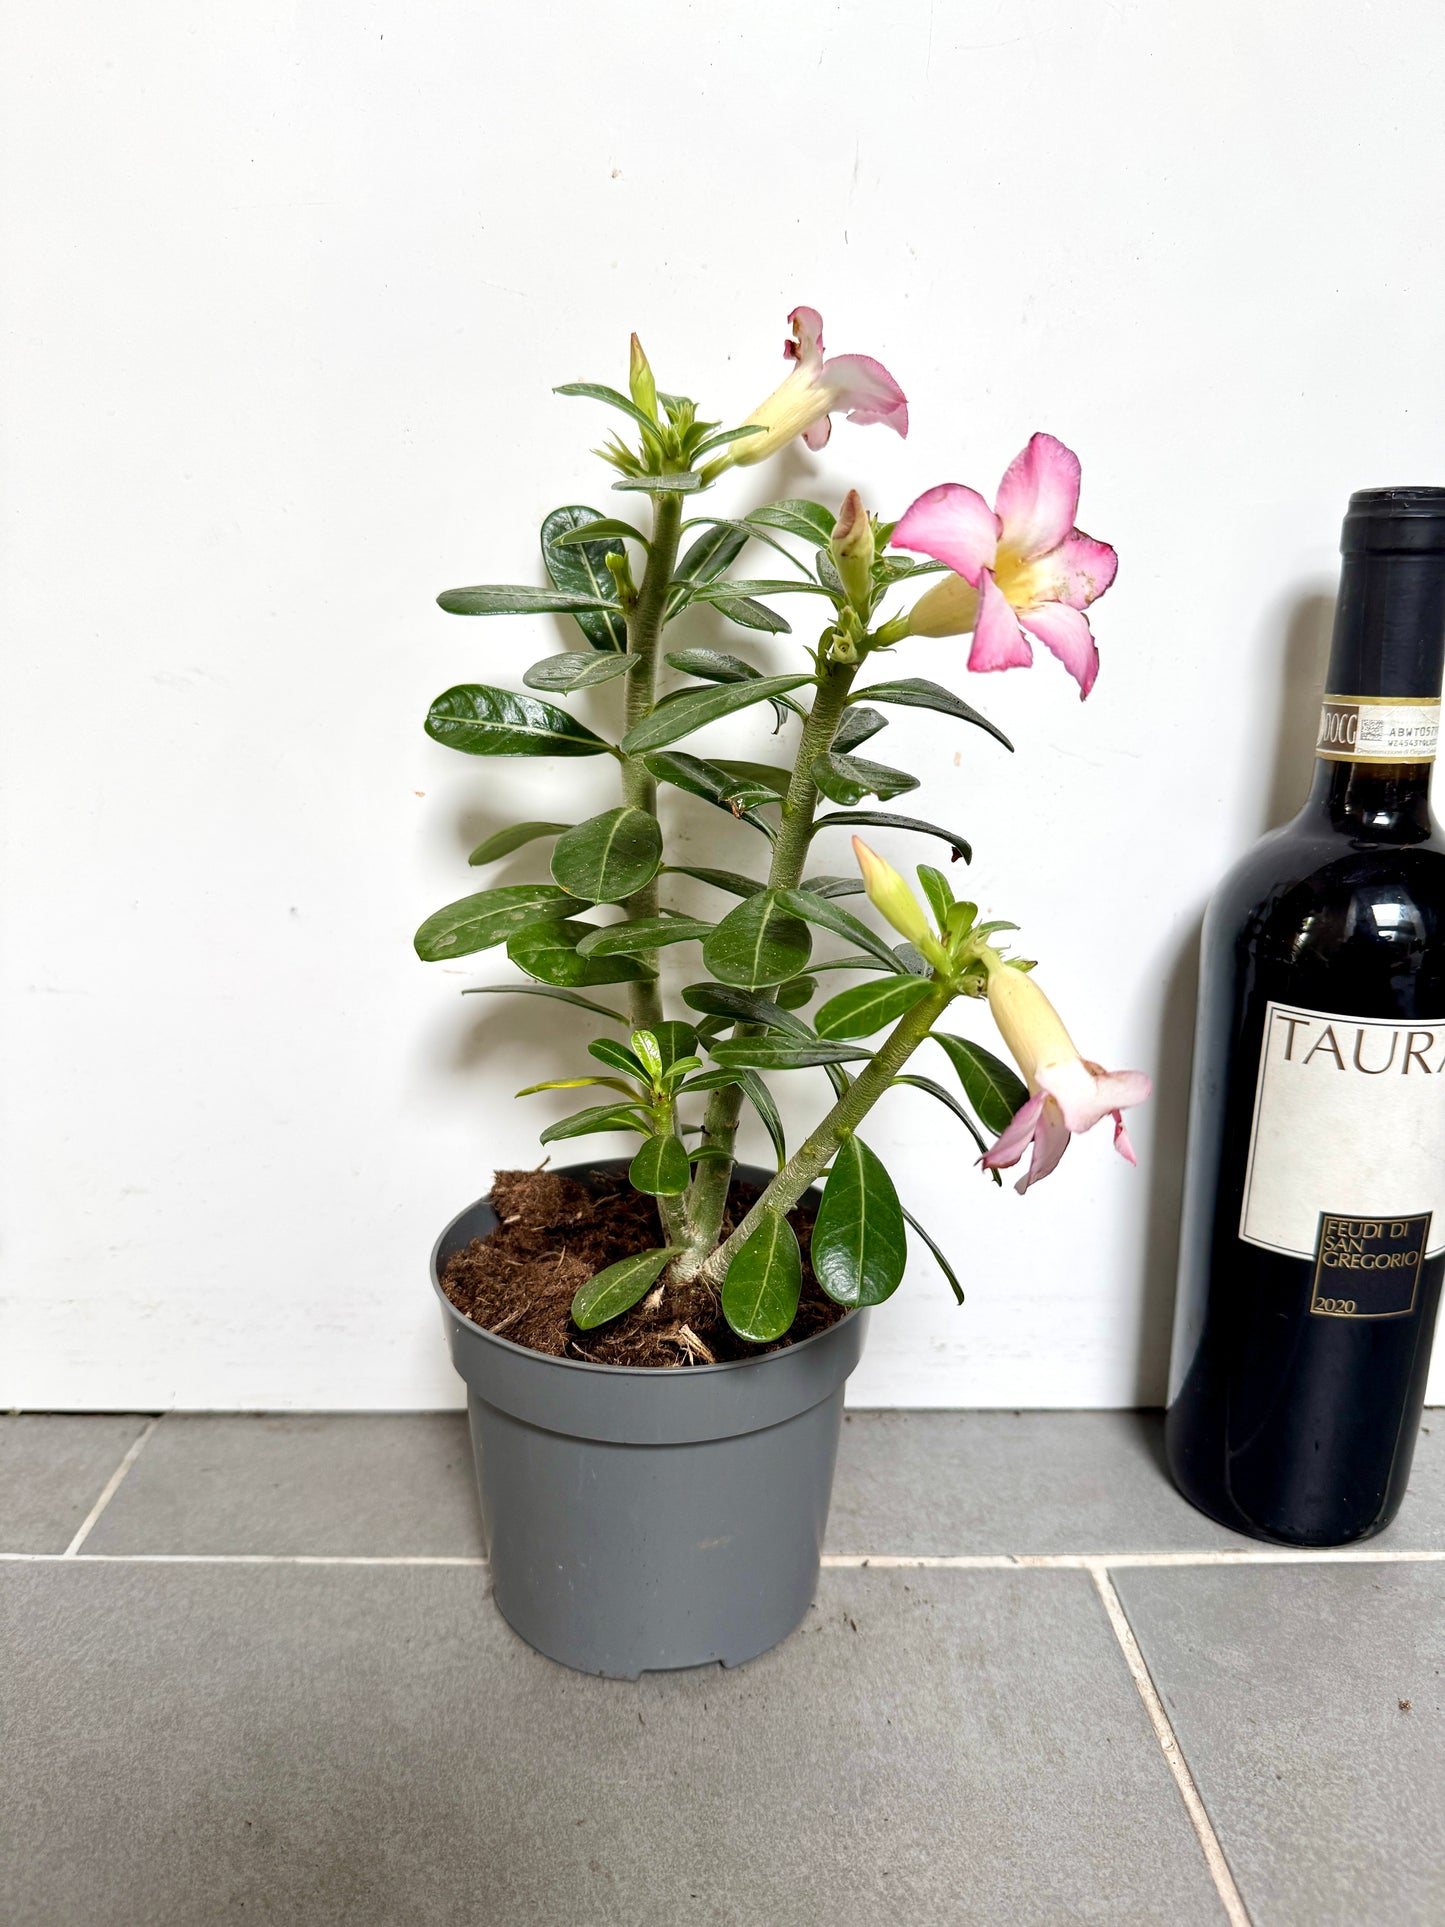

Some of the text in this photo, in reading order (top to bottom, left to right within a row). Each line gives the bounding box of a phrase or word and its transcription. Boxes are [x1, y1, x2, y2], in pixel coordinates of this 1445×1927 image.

[1276, 1015, 1445, 1075] TAUR
[1326, 1220, 1409, 1239] FEUDI DI
[1324, 1235, 1364, 1253] SAN
[1322, 1250, 1419, 1270] GREGORIO
[1314, 1297, 1356, 1314] 2020
